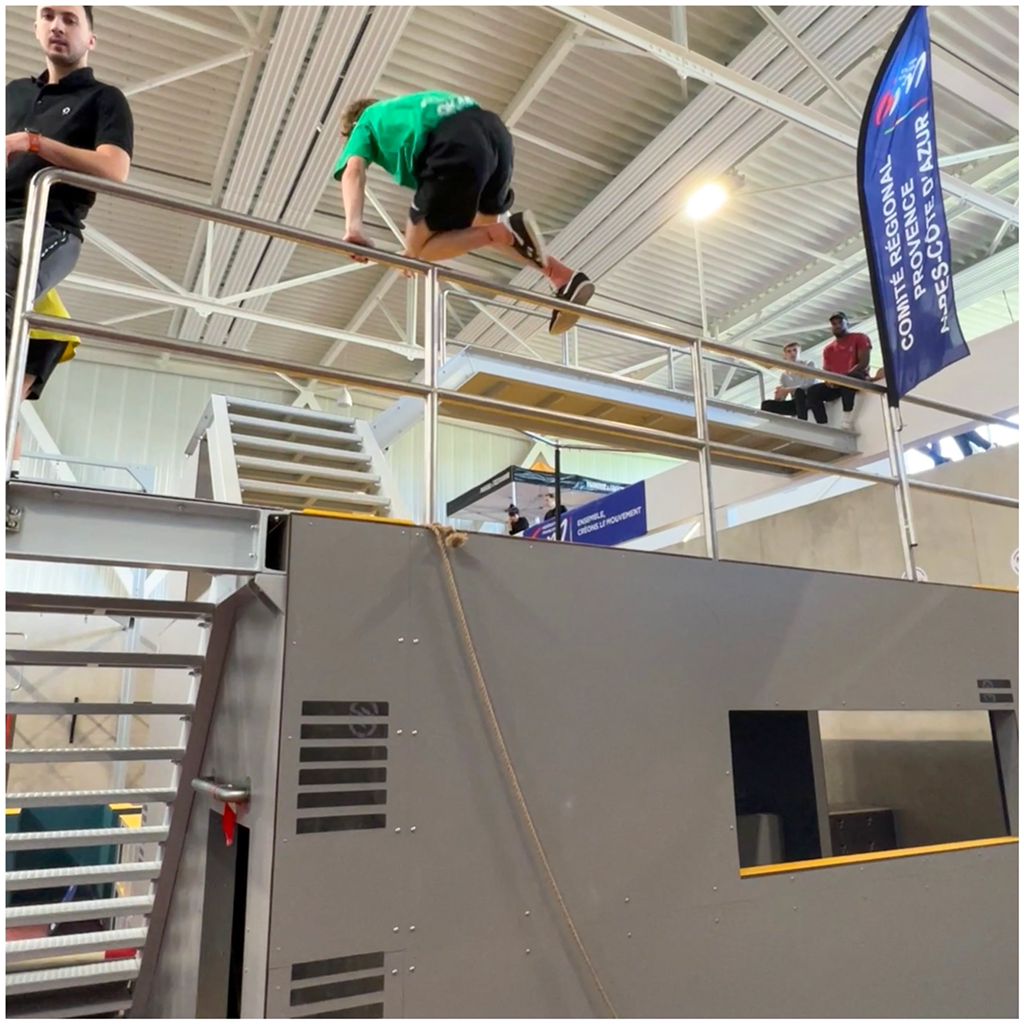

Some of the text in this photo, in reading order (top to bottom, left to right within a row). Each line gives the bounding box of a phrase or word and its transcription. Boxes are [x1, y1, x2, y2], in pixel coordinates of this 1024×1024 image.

[879, 154, 914, 351] COMITÉ RÉGIONAL
[901, 178, 926, 300] PROVENCE
